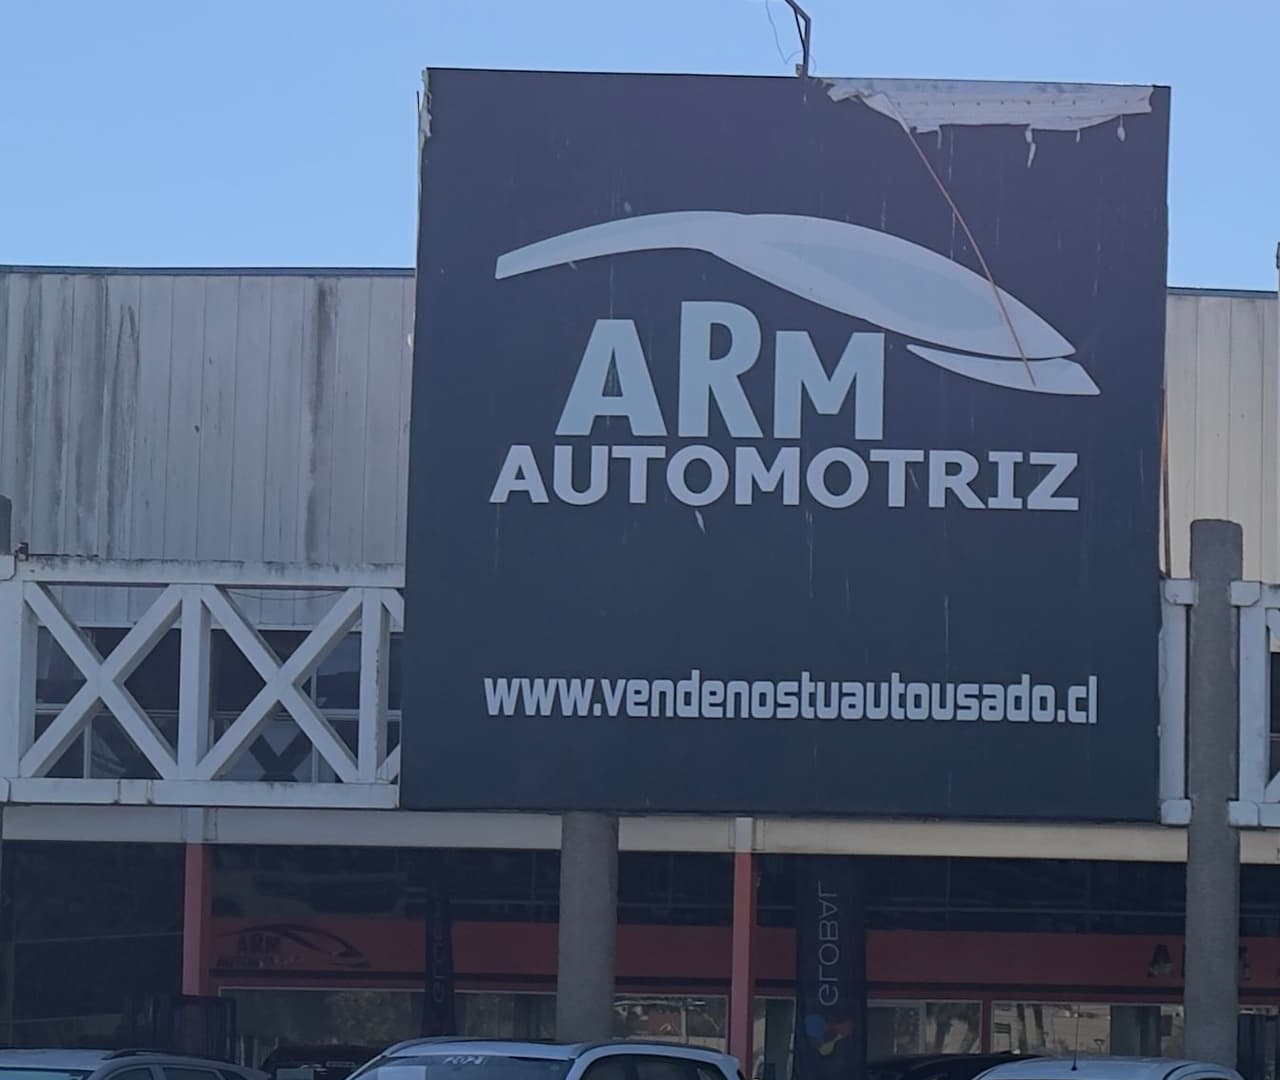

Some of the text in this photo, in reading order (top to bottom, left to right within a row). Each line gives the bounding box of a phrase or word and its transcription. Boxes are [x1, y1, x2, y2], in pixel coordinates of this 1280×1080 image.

[555, 300, 886, 441] ARM
[489, 444, 1080, 512] AUTOMOTRIZ
[483, 669, 1099, 725] www.vendenostuautousado.cl
